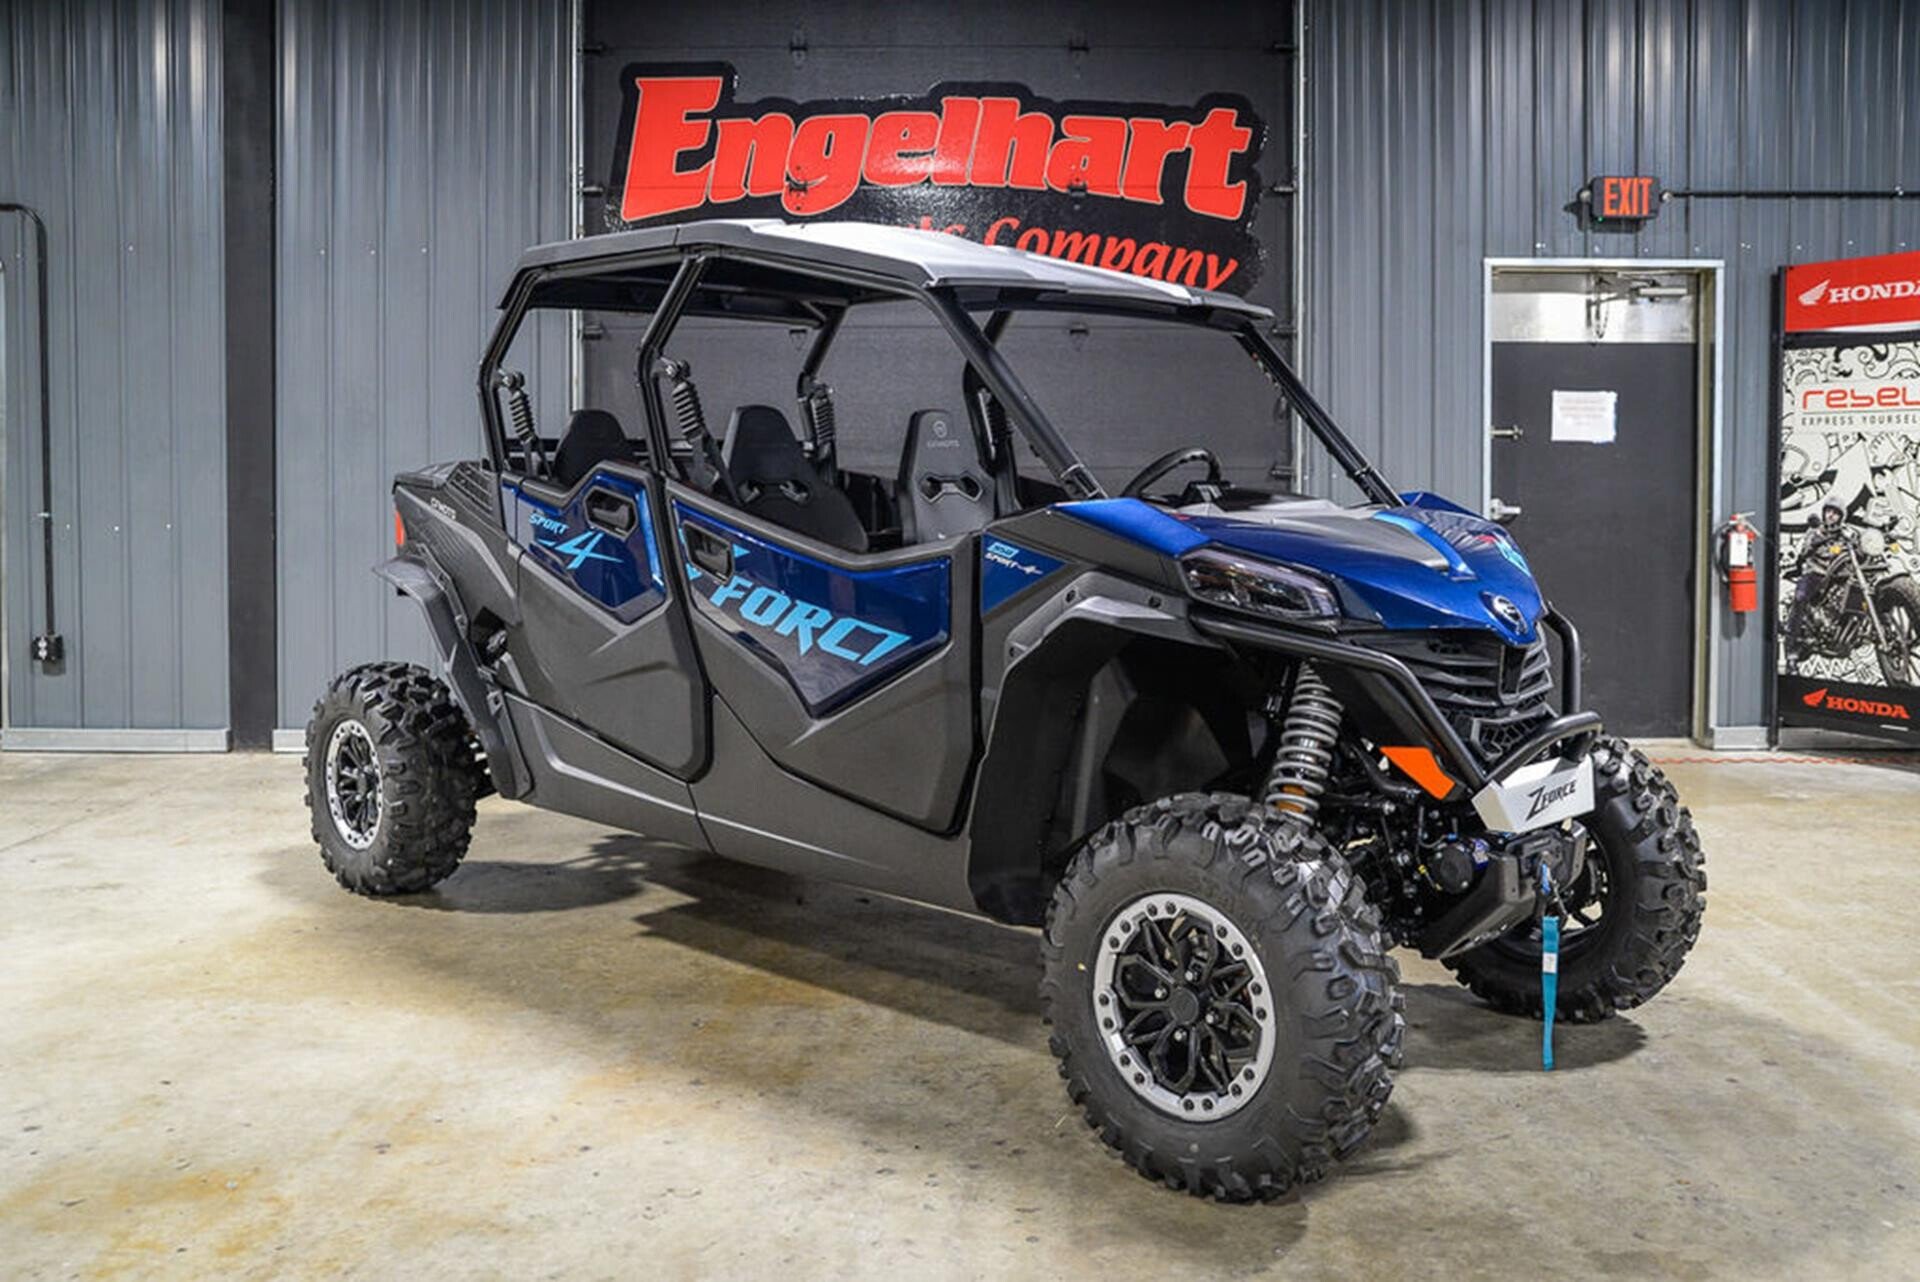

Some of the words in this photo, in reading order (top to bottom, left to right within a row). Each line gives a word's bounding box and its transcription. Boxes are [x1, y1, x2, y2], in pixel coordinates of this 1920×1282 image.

[621, 76, 1253, 221] Engelhart
[1603, 177, 1654, 216] EXIT
[983, 216, 1239, 291] Company
[1801, 415, 1854, 426] EXPRESS
[1862, 413, 1920, 425] YOURSEL
[528, 512, 570, 535] SPORT
[1826, 695, 1911, 720] HONDA
